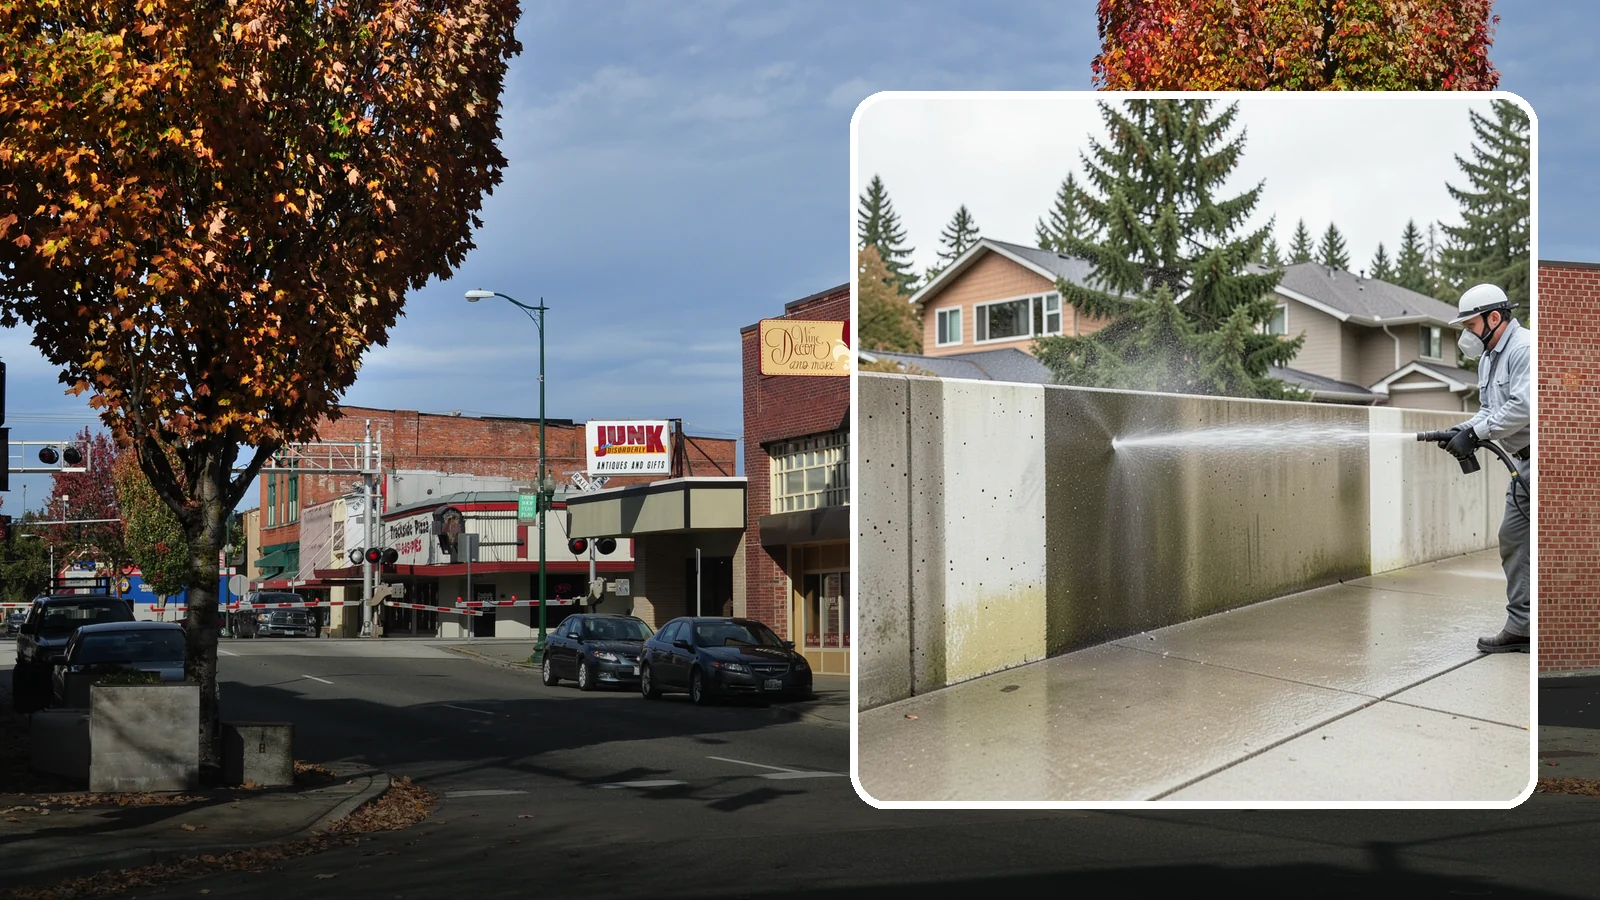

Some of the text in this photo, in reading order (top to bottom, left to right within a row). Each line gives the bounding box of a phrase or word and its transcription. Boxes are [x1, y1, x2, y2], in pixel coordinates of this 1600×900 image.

[595, 425, 665, 457] JUNK
[607, 446, 646, 454] DISORDERLY
[597, 460, 665, 470] ANTIQUES AND GIFTS
[573, 473, 589, 492] RAIL
[390, 520, 429, 540] Trackside Pizza
